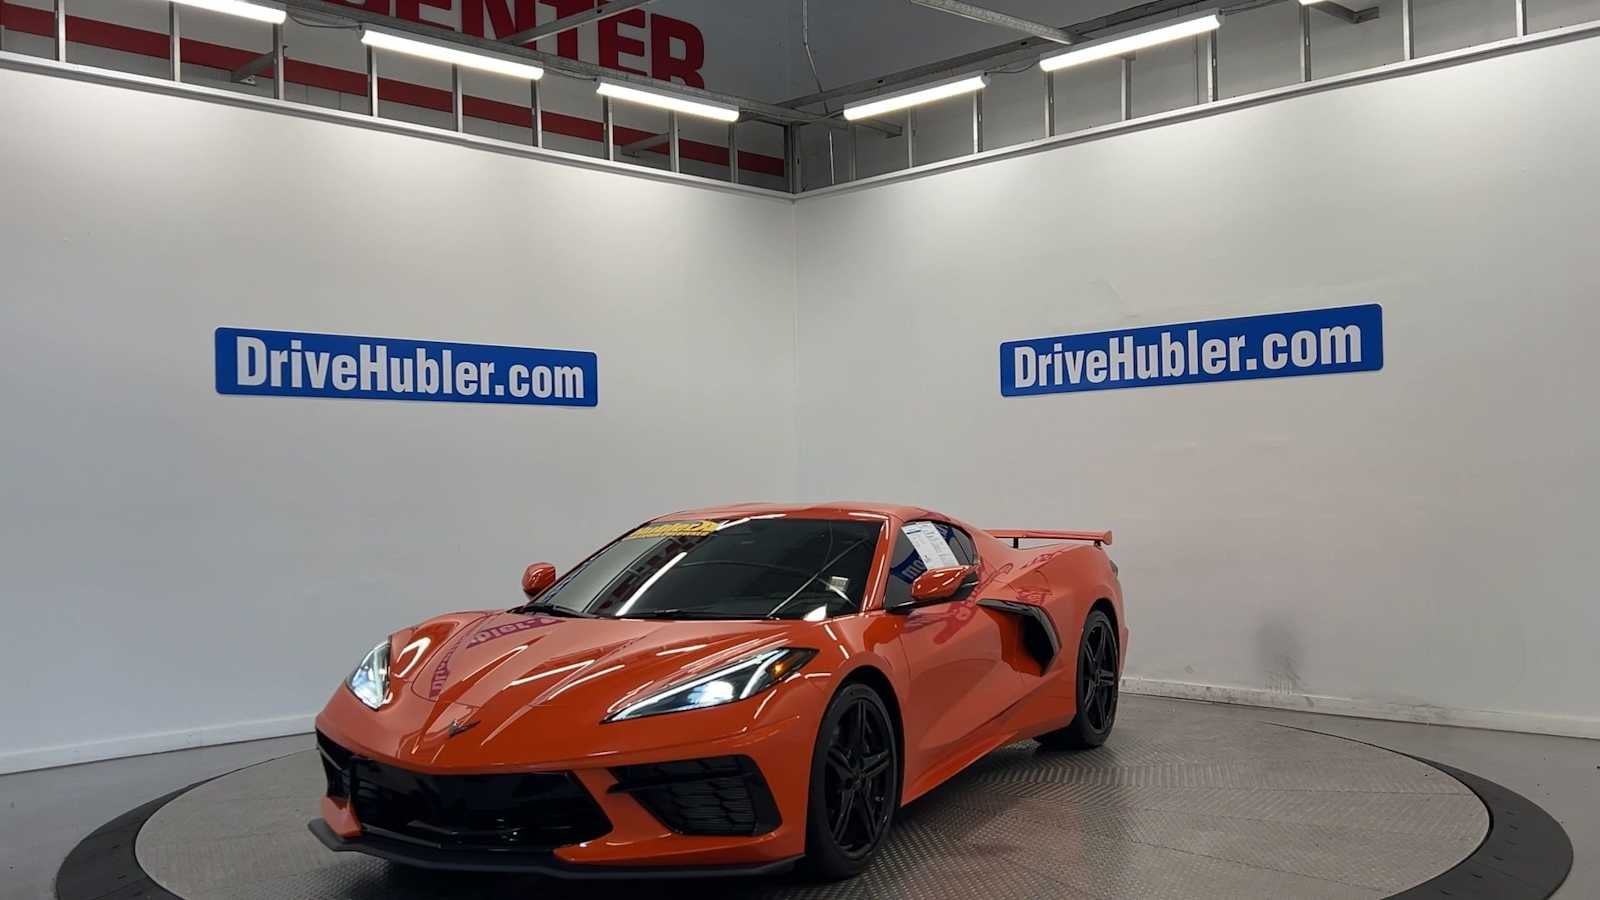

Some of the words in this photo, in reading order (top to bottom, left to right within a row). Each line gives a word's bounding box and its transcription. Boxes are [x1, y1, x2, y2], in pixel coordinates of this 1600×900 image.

[320, 0, 704, 89] NTER
[236, 336, 585, 399] DriveHubler.com
[1015, 324, 1362, 389] DriveHubler.com
